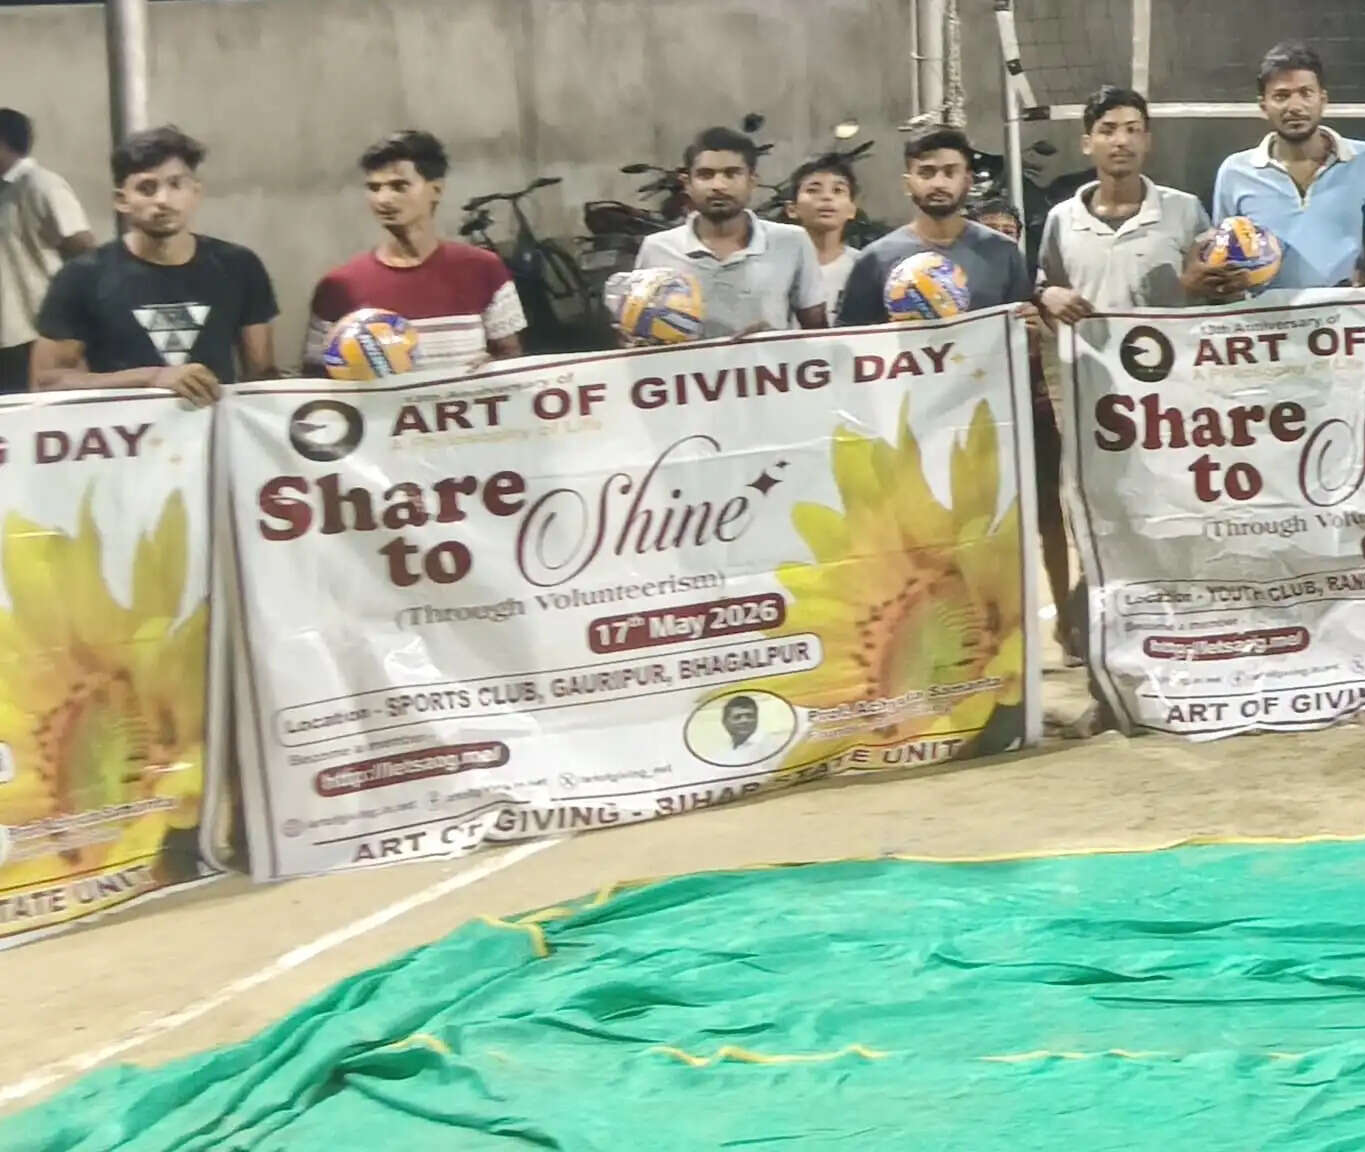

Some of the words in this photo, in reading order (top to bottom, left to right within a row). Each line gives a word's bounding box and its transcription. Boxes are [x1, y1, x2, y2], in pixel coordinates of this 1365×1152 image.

[1326, 313, 1341, 326] of
[1193, 332, 1288, 366] ART
[391, 394, 510, 437] ART
[533, 383, 607, 421] OF
[631, 358, 832, 410] GIVING
[853, 342, 954, 385] DAY
[35, 423, 154, 464] DAY
[1094, 393, 1307, 452] Share
[1188, 454, 1263, 502] to
[259, 470, 526, 541] Share
[517, 434, 751, 588] Shine
[1203, 516, 1307, 540] (Through
[379, 536, 473, 587] to
[397, 598, 526, 631] (Through
[535, 569, 726, 611] Volunteerism)
[1266, 580, 1324, 603] CLUB,
[650, 614, 706, 639] May
[709, 600, 778, 630] 2026
[385, 690, 472, 717] SPORTS
[479, 681, 545, 707] CLUB,
[551, 663, 673, 697] GAURIPUR,
[679, 641, 811, 681] BHAGALPUR
[1167, 703, 1232, 724] ART
[1241, 697, 1279, 718] OF
[353, 833, 427, 863] ART
[495, 802, 619, 833] GIVING
[883, 738, 962, 764] UNIT
